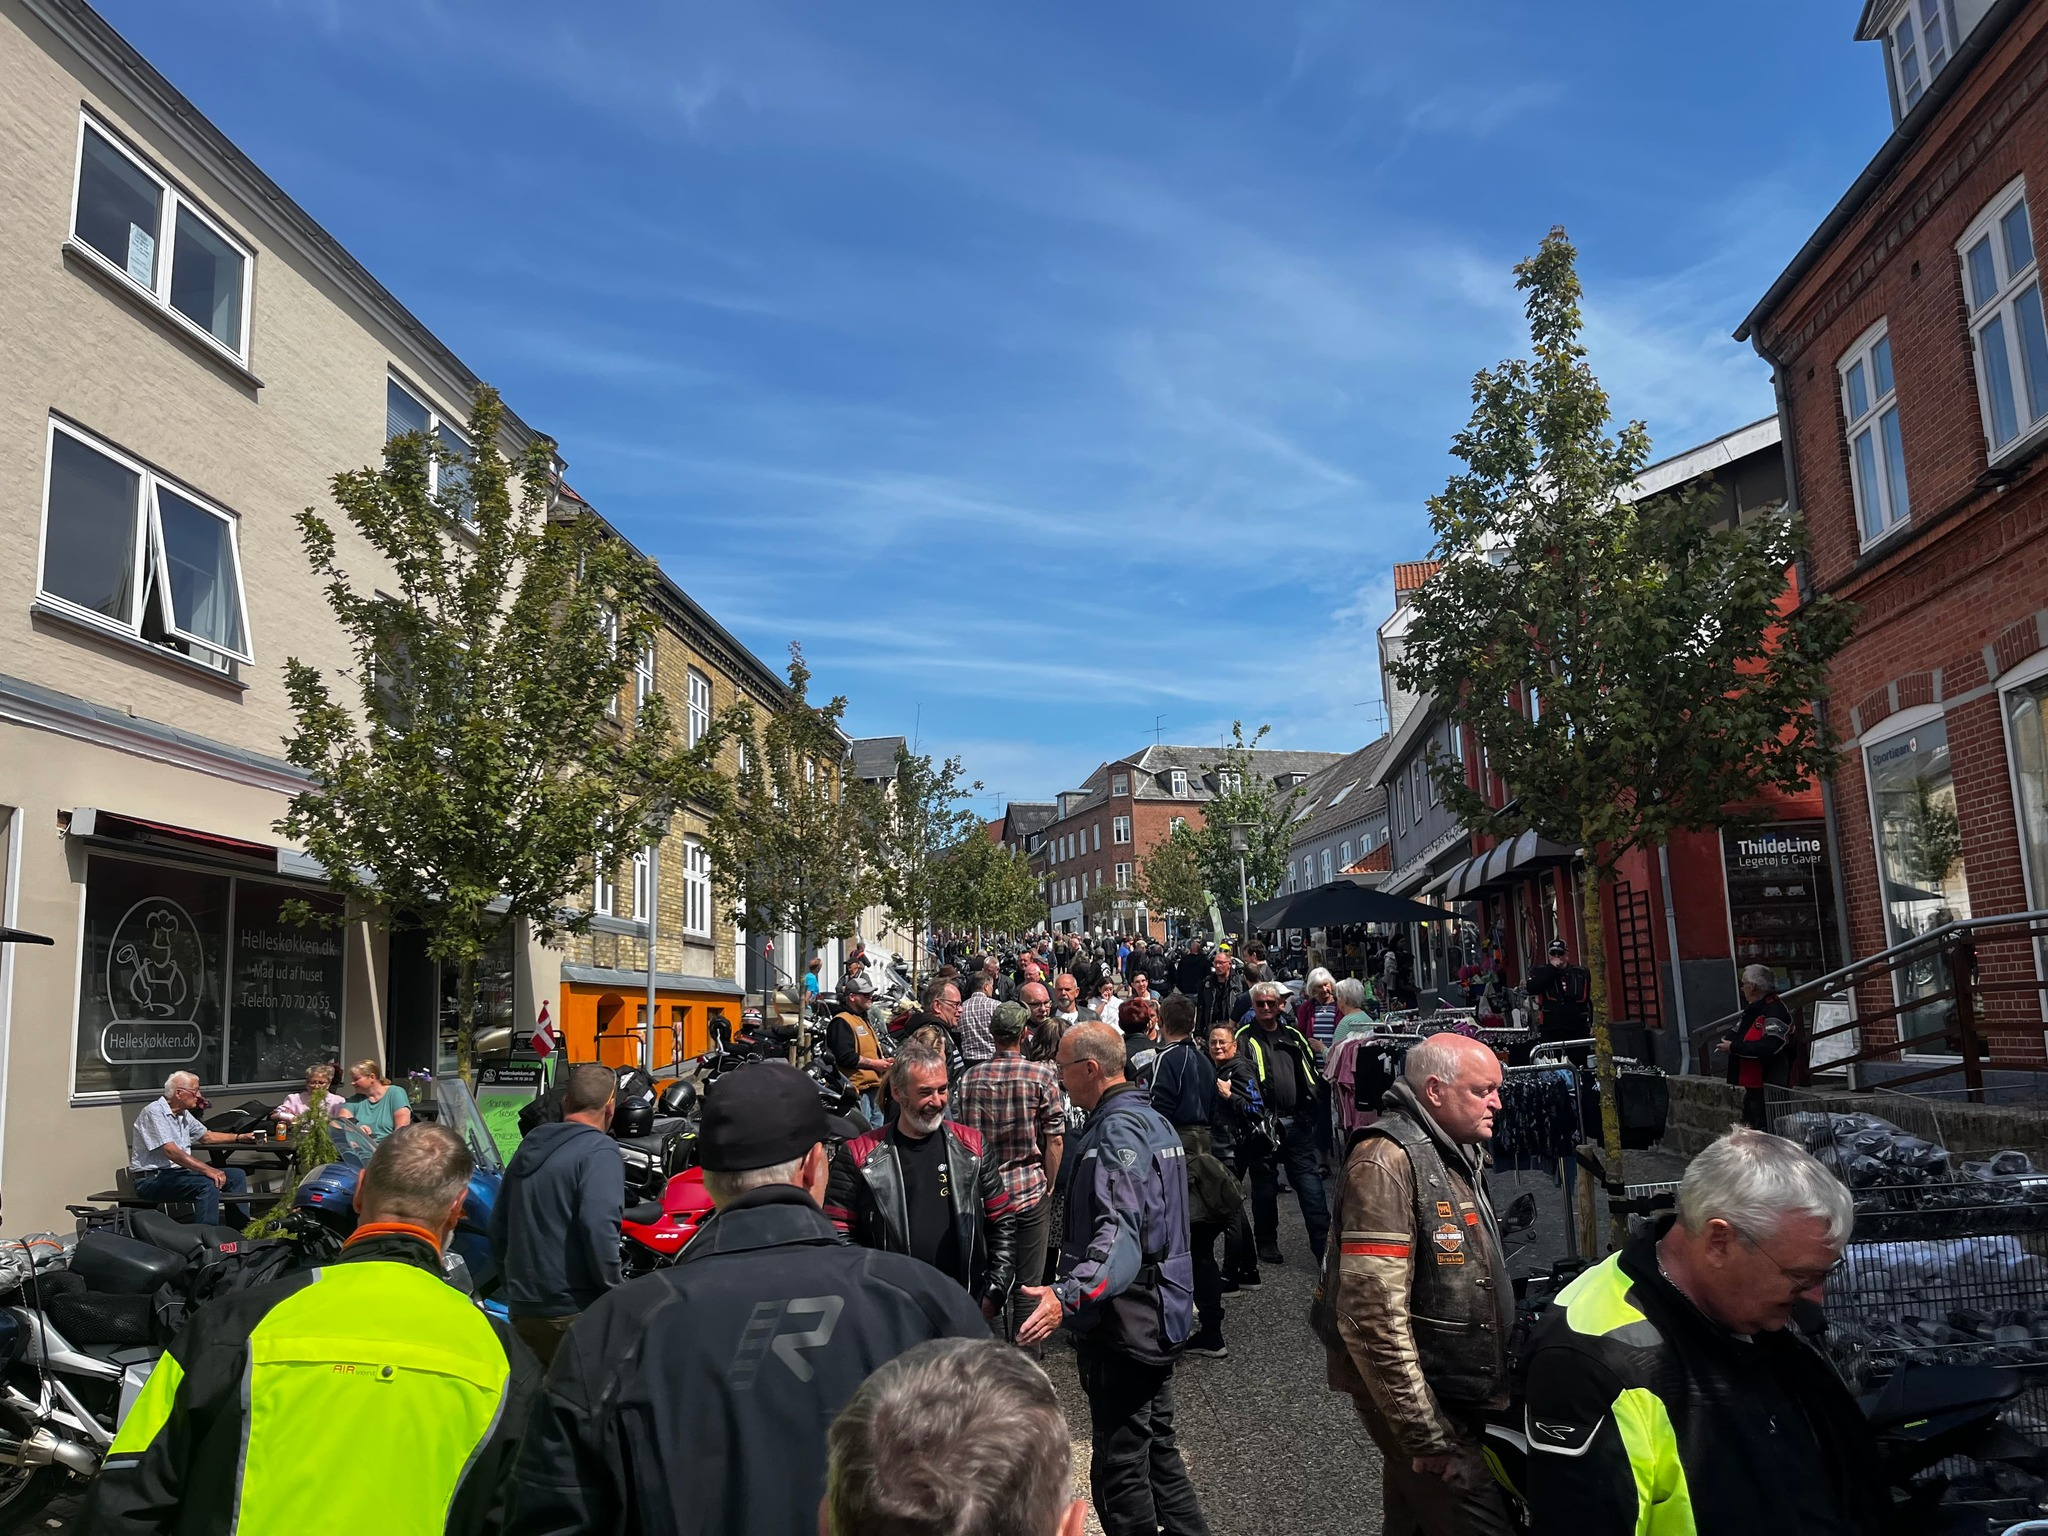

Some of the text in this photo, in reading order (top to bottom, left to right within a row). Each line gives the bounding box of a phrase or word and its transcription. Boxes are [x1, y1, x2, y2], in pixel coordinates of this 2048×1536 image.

[1872, 744, 1909, 766] Sportigan
[1737, 837, 1821, 855] ThildeLine
[1739, 854, 1821, 869] Legetøj & Gaver
[241, 929, 336, 956] Helleskøkken.dk
[253, 963, 323, 981] Mad ud af huset
[241, 992, 330, 1010] Telefon 70 70 20 55
[109, 1032, 196, 1049] Helleskøkken.dk
